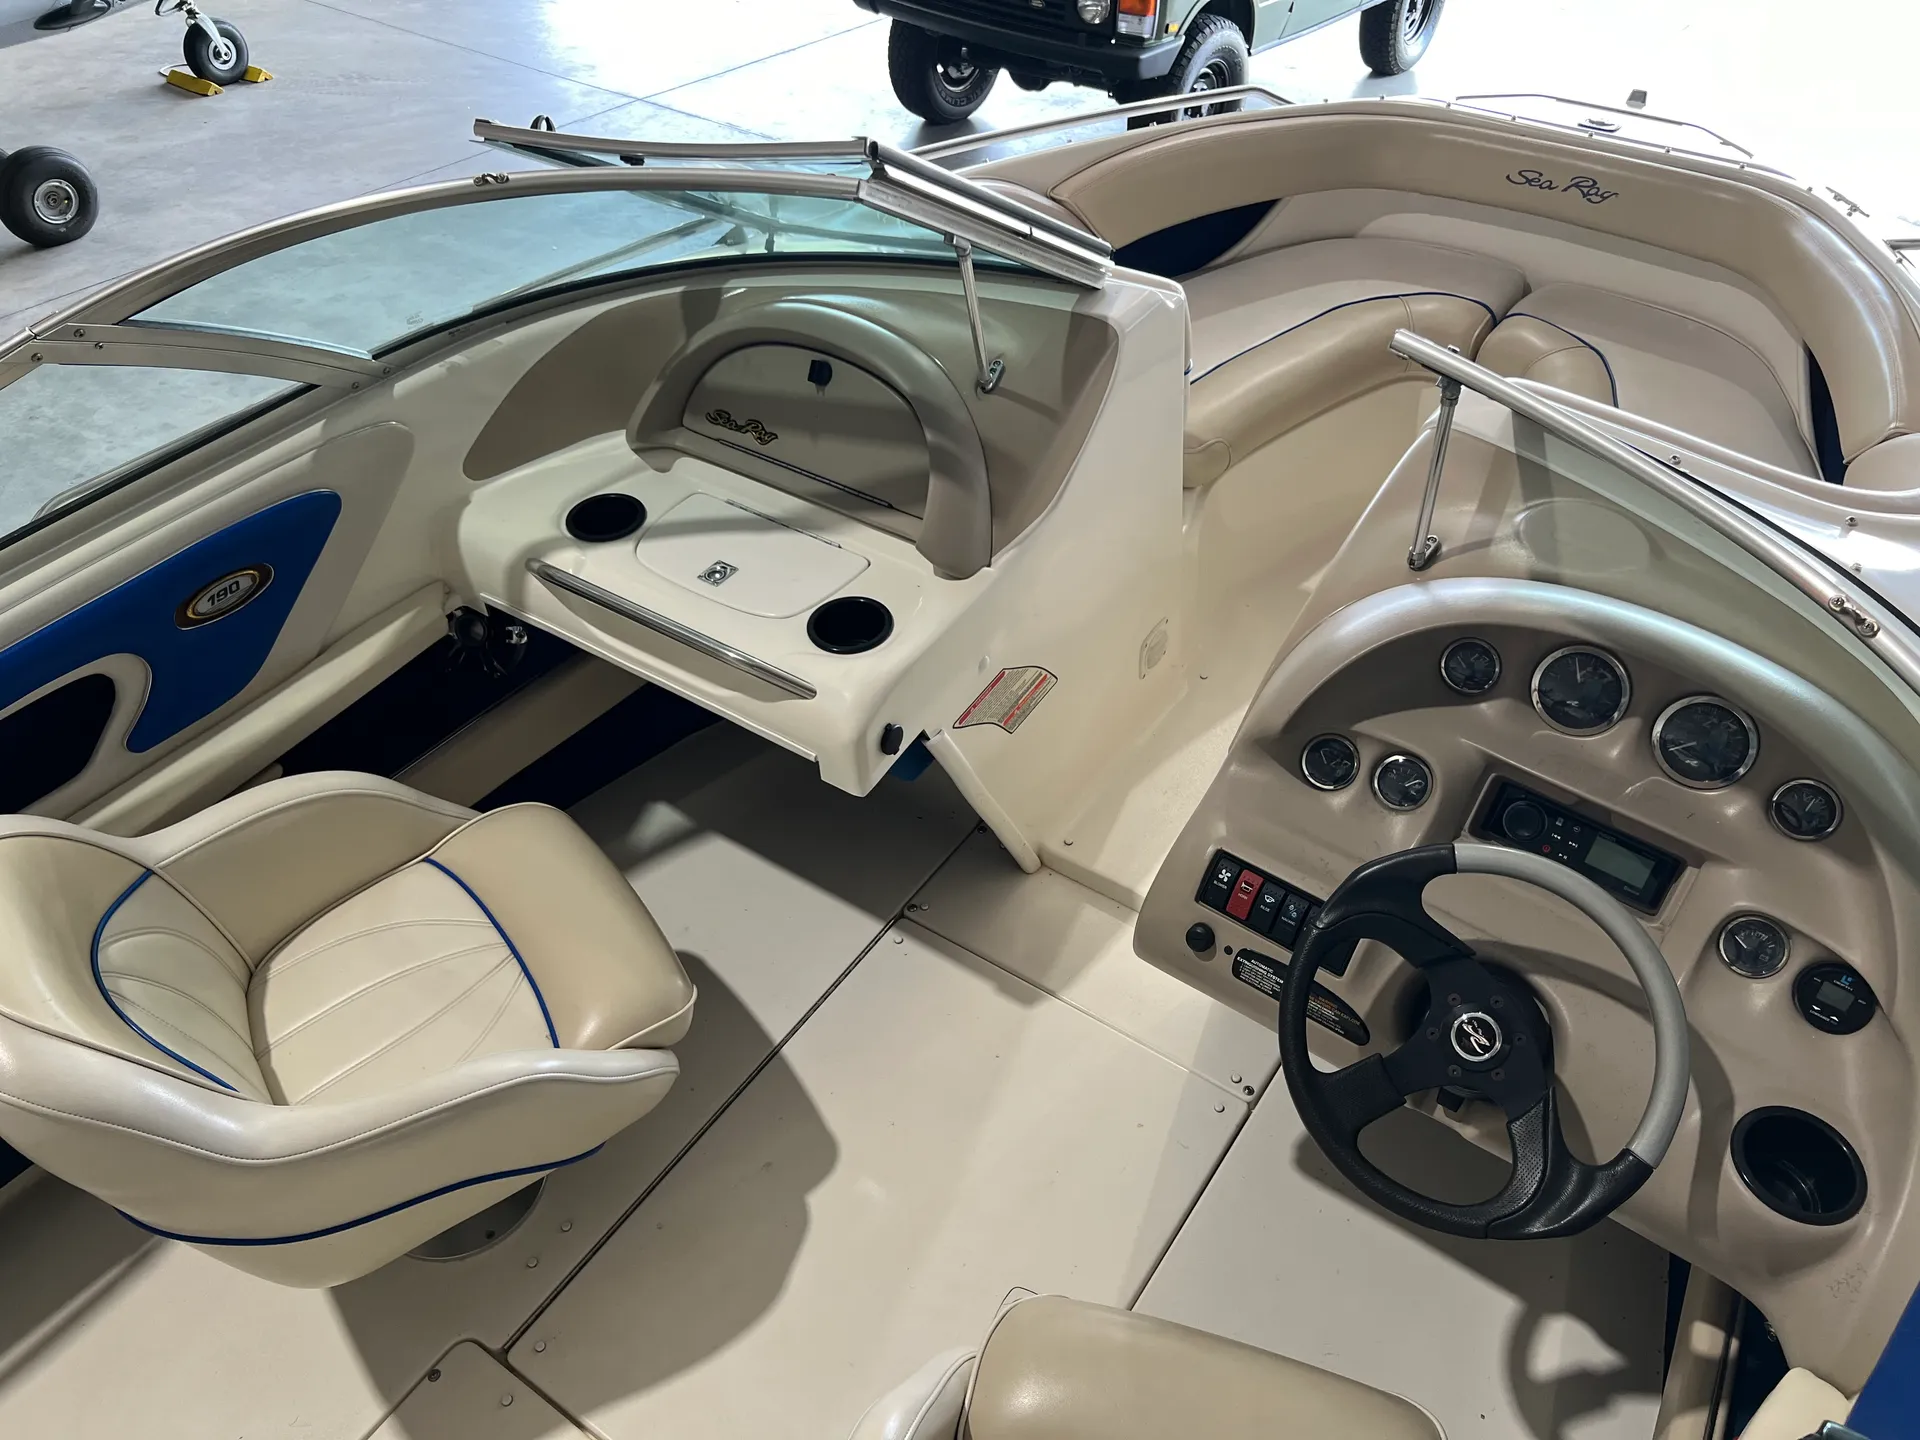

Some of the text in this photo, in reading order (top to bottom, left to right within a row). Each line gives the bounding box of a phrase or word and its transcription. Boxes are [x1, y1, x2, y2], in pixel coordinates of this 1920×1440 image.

[1505, 169, 1619, 204] Sea Ray
[705, 409, 779, 446] Sea Ray
[207, 580, 240, 607] 190
[1213, 880, 1227, 889] BLOWER
[1237, 892, 1248, 900] HORN
[1251, 959, 1274, 973] AUTOMATIC
[1267, 972, 1284, 984] SYSTEM
